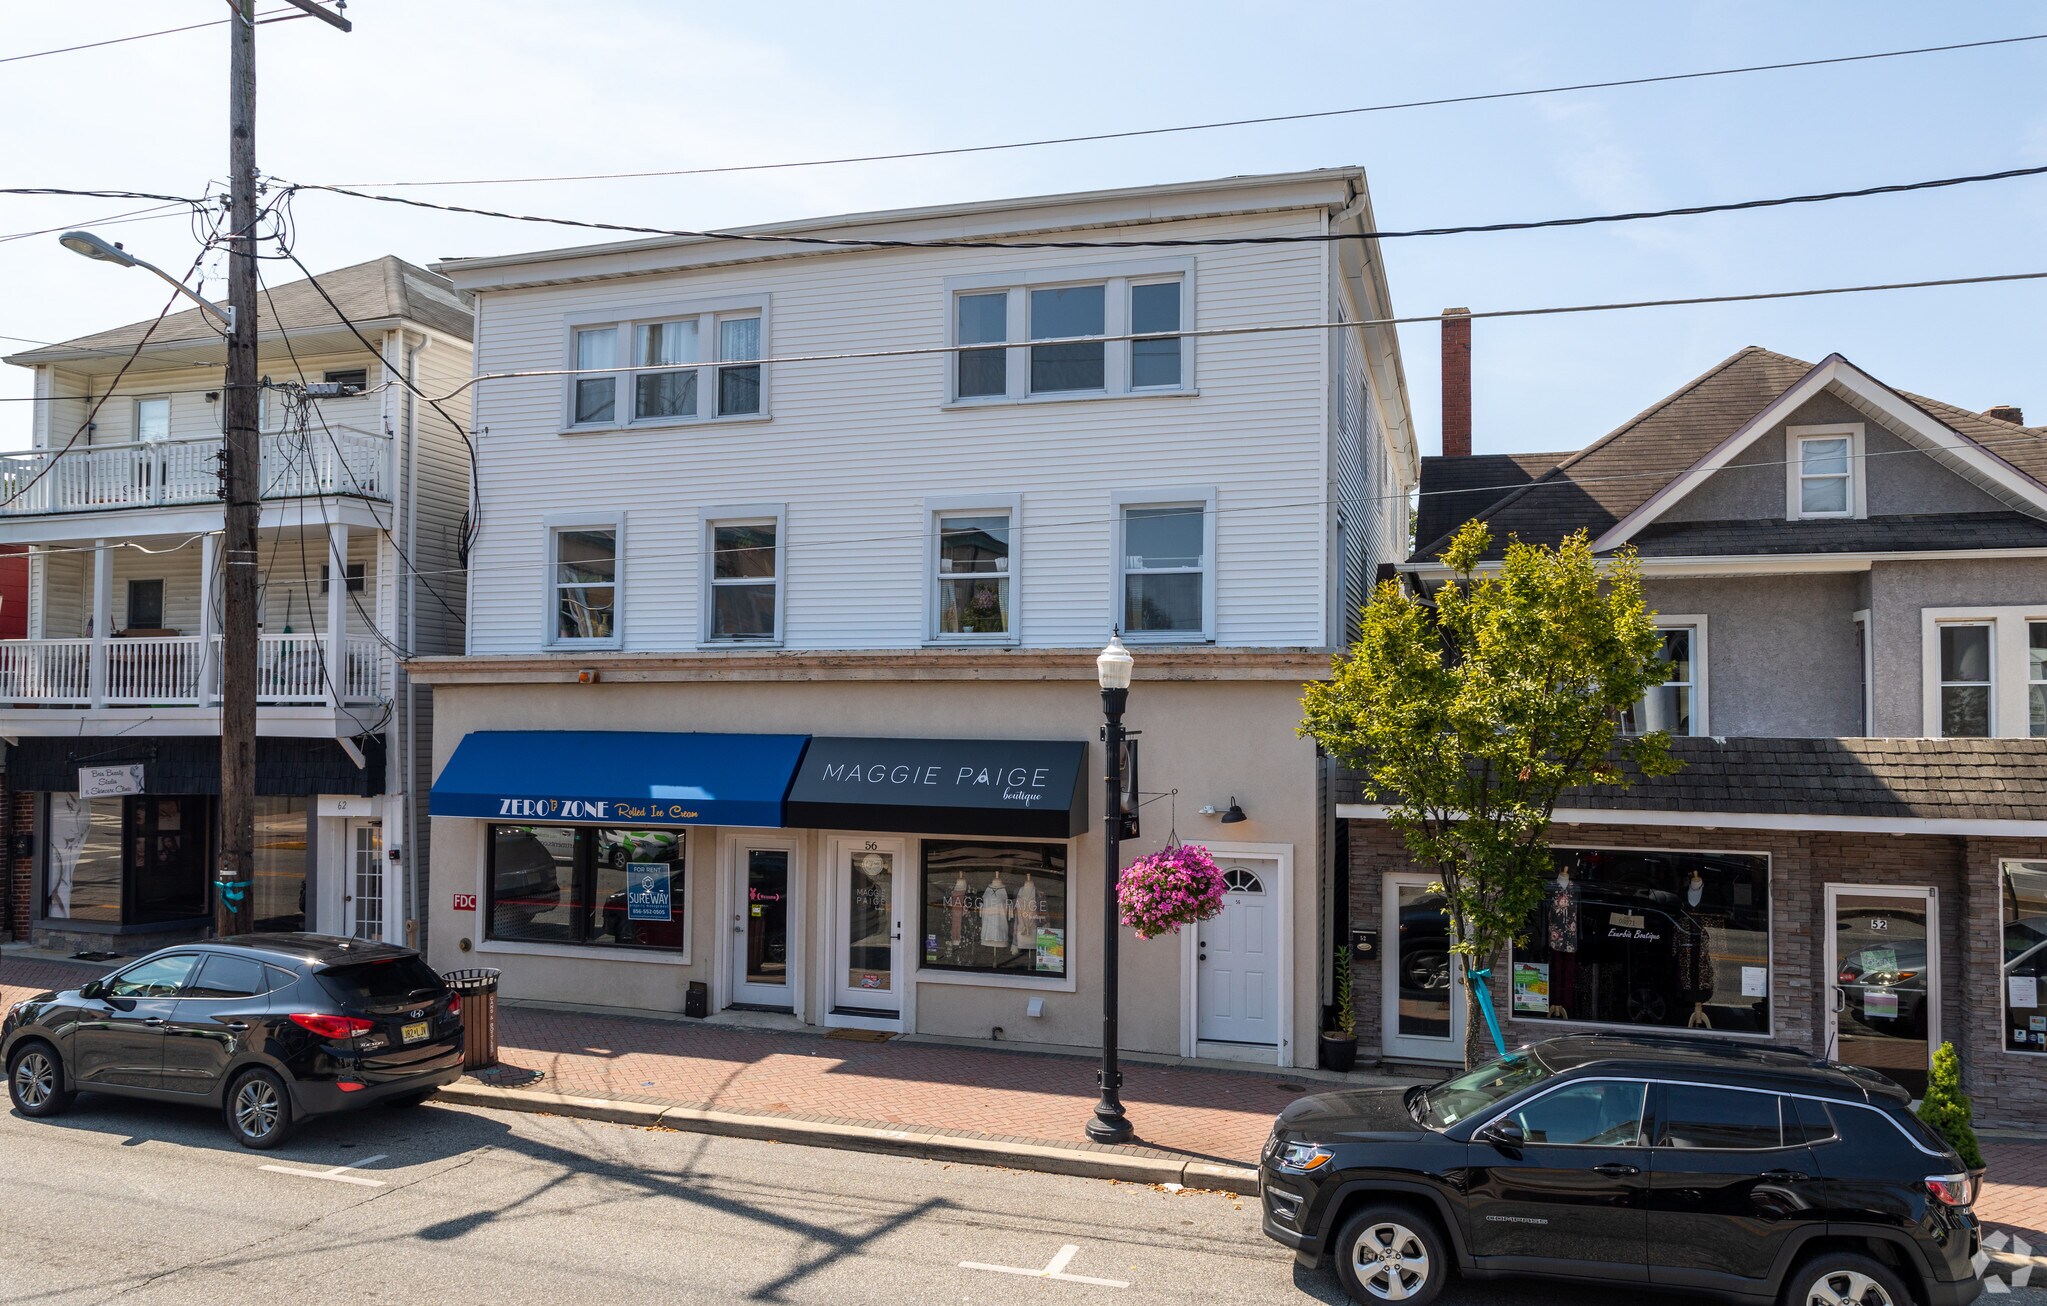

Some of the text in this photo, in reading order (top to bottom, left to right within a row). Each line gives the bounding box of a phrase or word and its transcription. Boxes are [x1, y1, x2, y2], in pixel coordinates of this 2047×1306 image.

[822, 763, 1050, 787] MAGGIE PAIGE
[1002, 786, 1043, 807] boutique
[337, 800, 347, 810] 62
[500, 798, 550, 817] ZERO
[560, 800, 609, 818] ZONE
[613, 803, 646, 819] Rolled
[650, 804, 664, 818] Ice
[668, 805, 699, 819] Cream
[865, 841, 878, 850] 56
[454, 894, 476, 908] FDC
[629, 892, 669, 905] SUREWAY
[856, 897, 887, 906] PAIGE
[942, 895, 1048, 912] MAGGIE PAIGE
[1872, 920, 1887, 929] 52
[1633, 929, 1660, 943] Boutique
[1485, 1215, 1549, 1225] COMPASS
